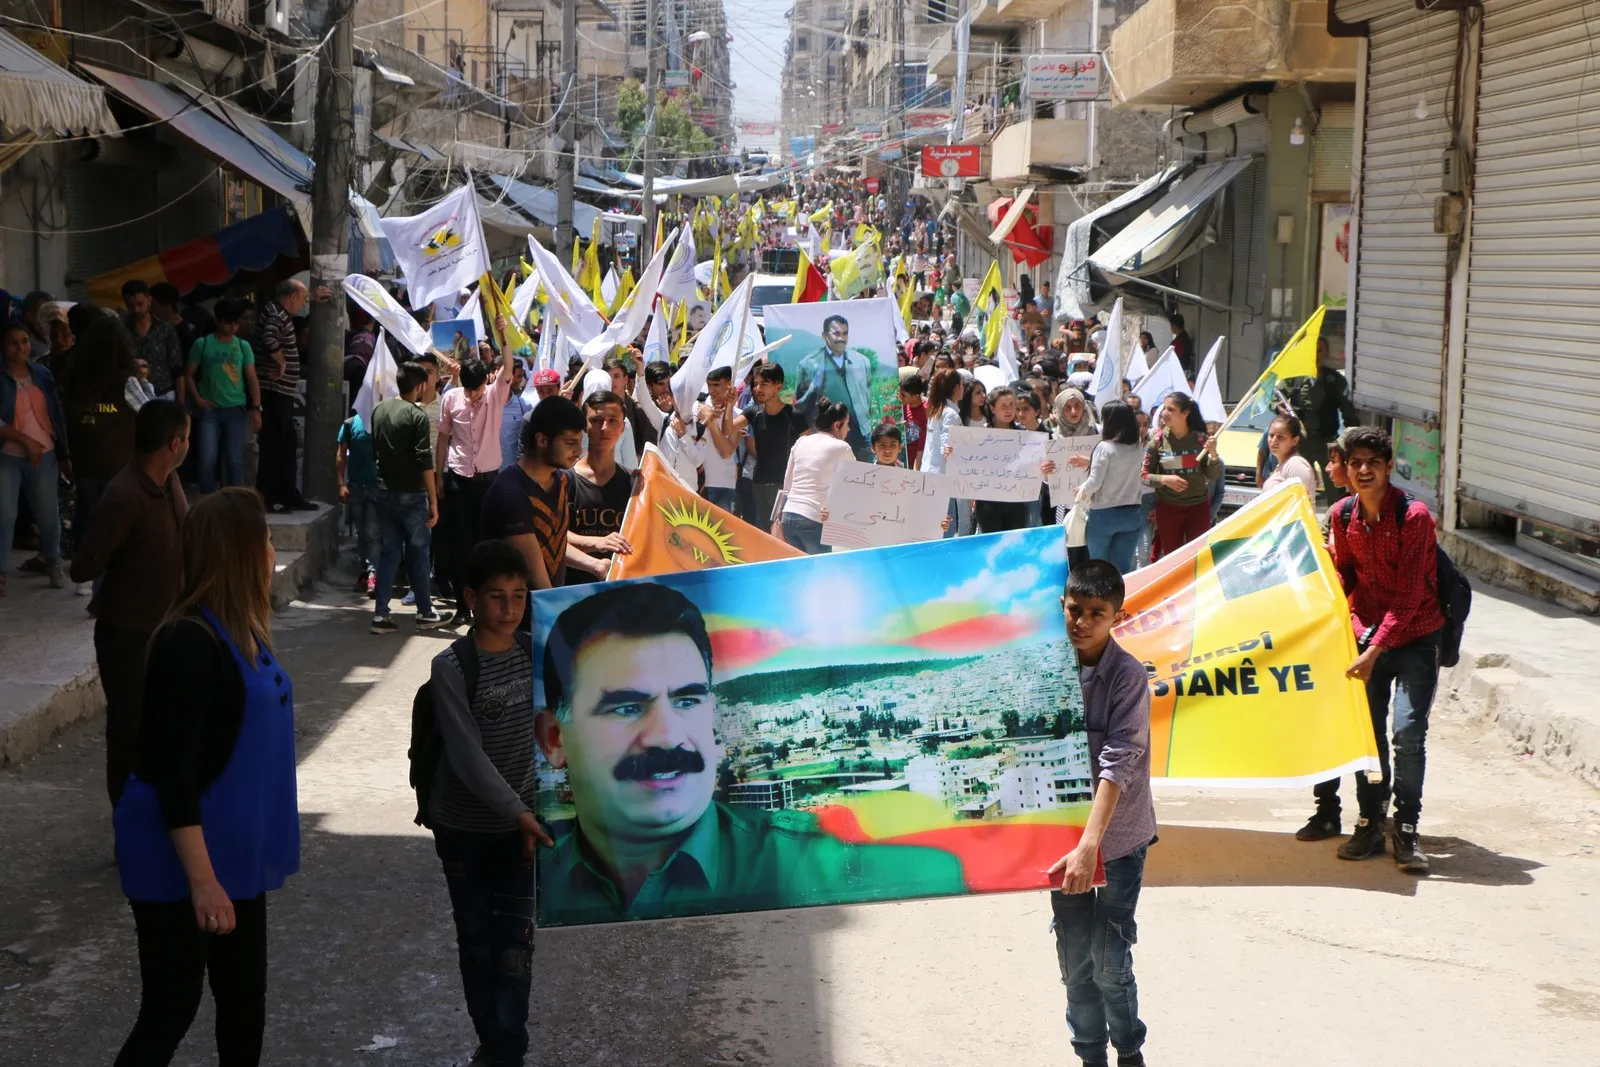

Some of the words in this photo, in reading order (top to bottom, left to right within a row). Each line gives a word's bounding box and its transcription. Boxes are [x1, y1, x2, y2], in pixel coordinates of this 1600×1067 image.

[1170, 631, 1273, 673] KURDÎ
[1152, 657, 1260, 698] STANÊ
[1268, 664, 1315, 693] YE
